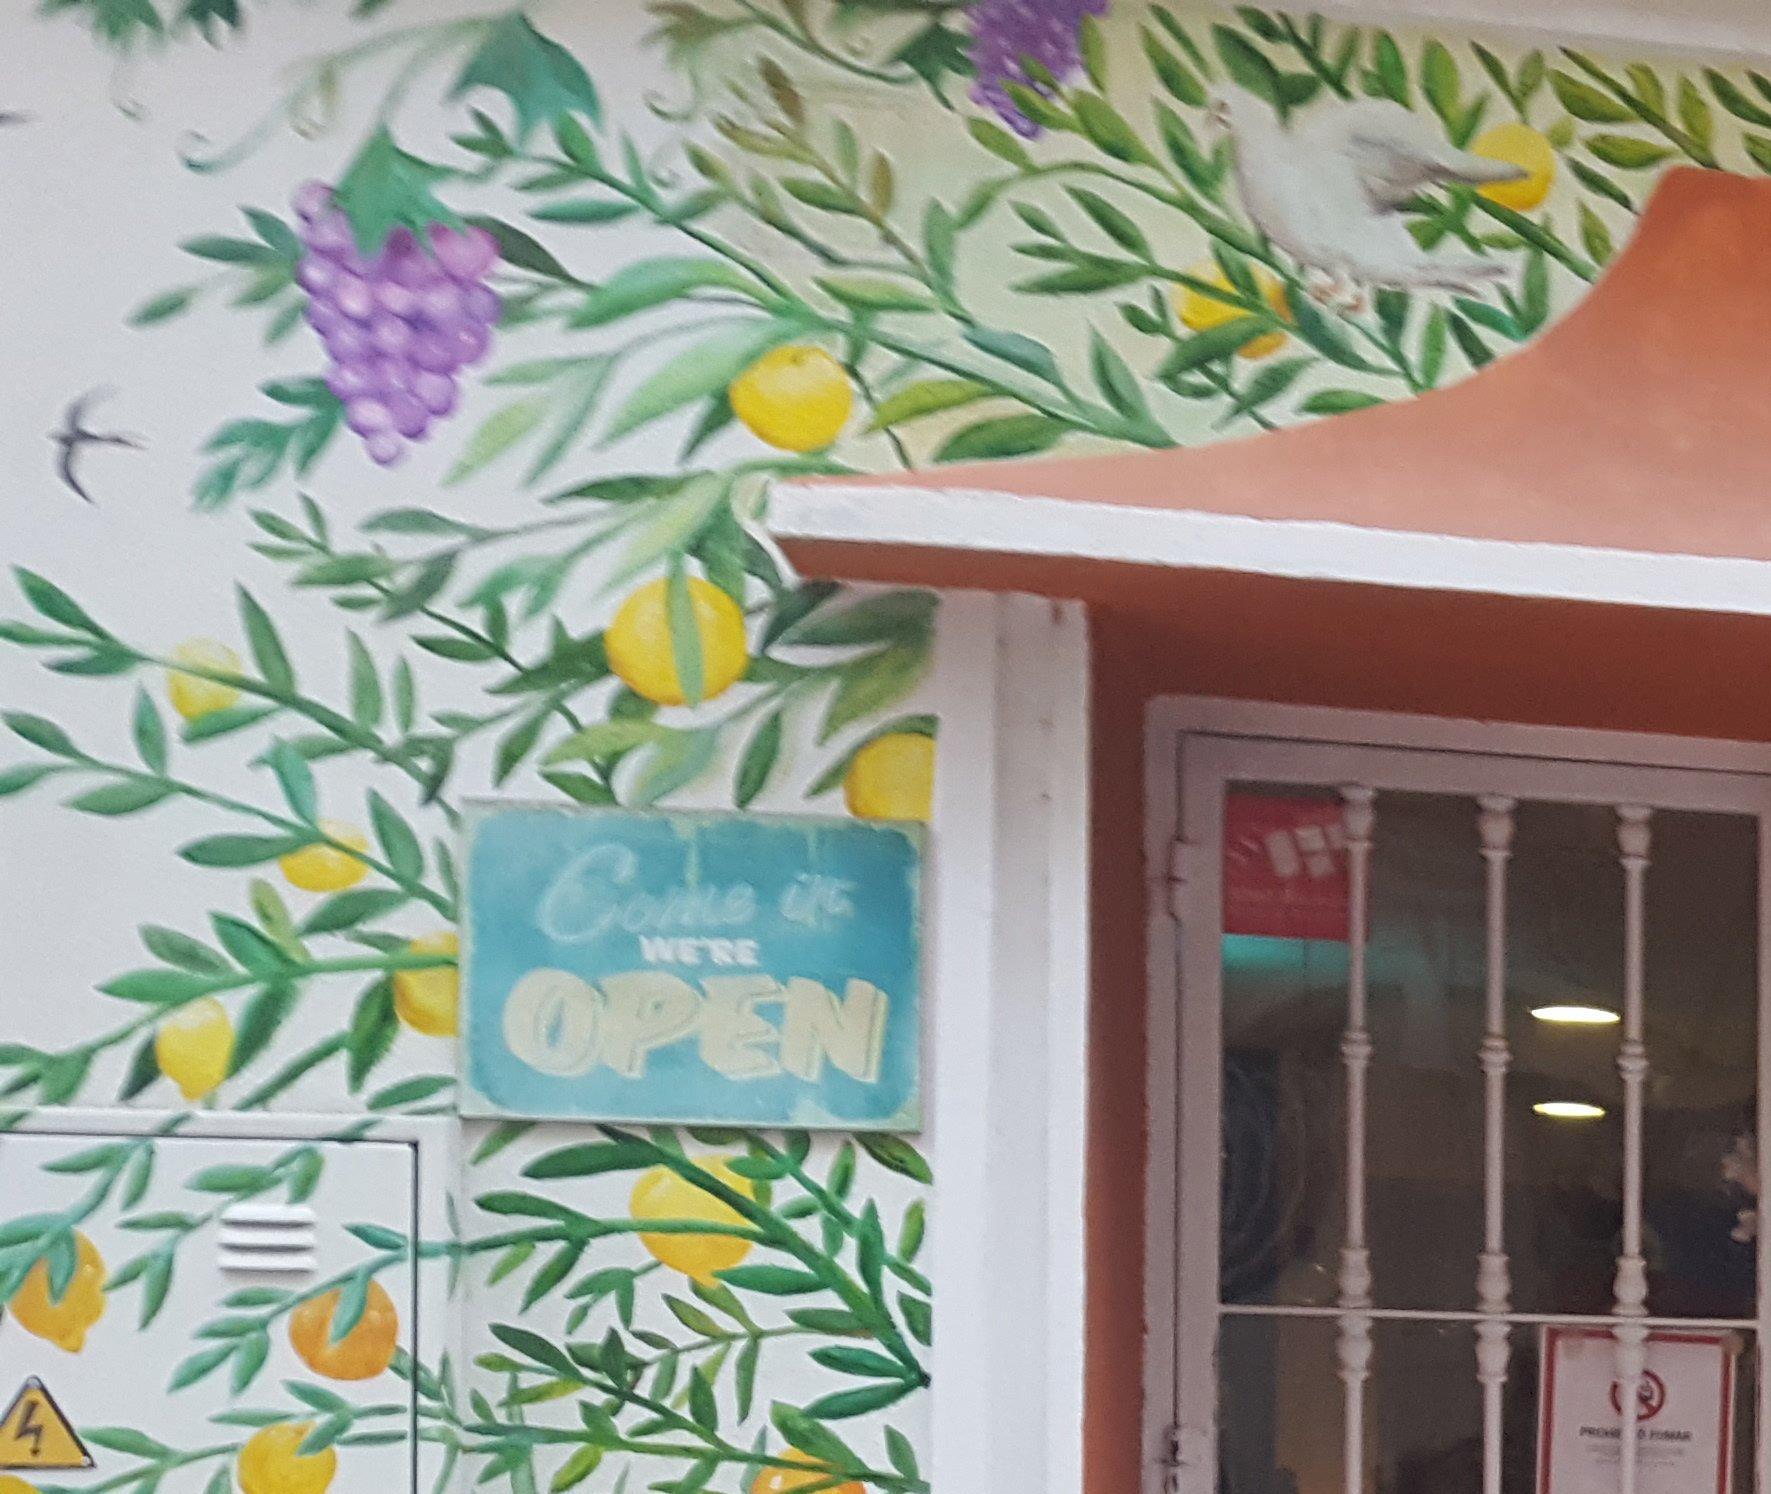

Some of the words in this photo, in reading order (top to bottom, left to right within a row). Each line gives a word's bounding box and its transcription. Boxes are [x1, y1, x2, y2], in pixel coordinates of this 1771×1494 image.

[537, 842, 758, 943] Come
[638, 935, 761, 966] WE'RE
[502, 966, 891, 1084] OPEN
